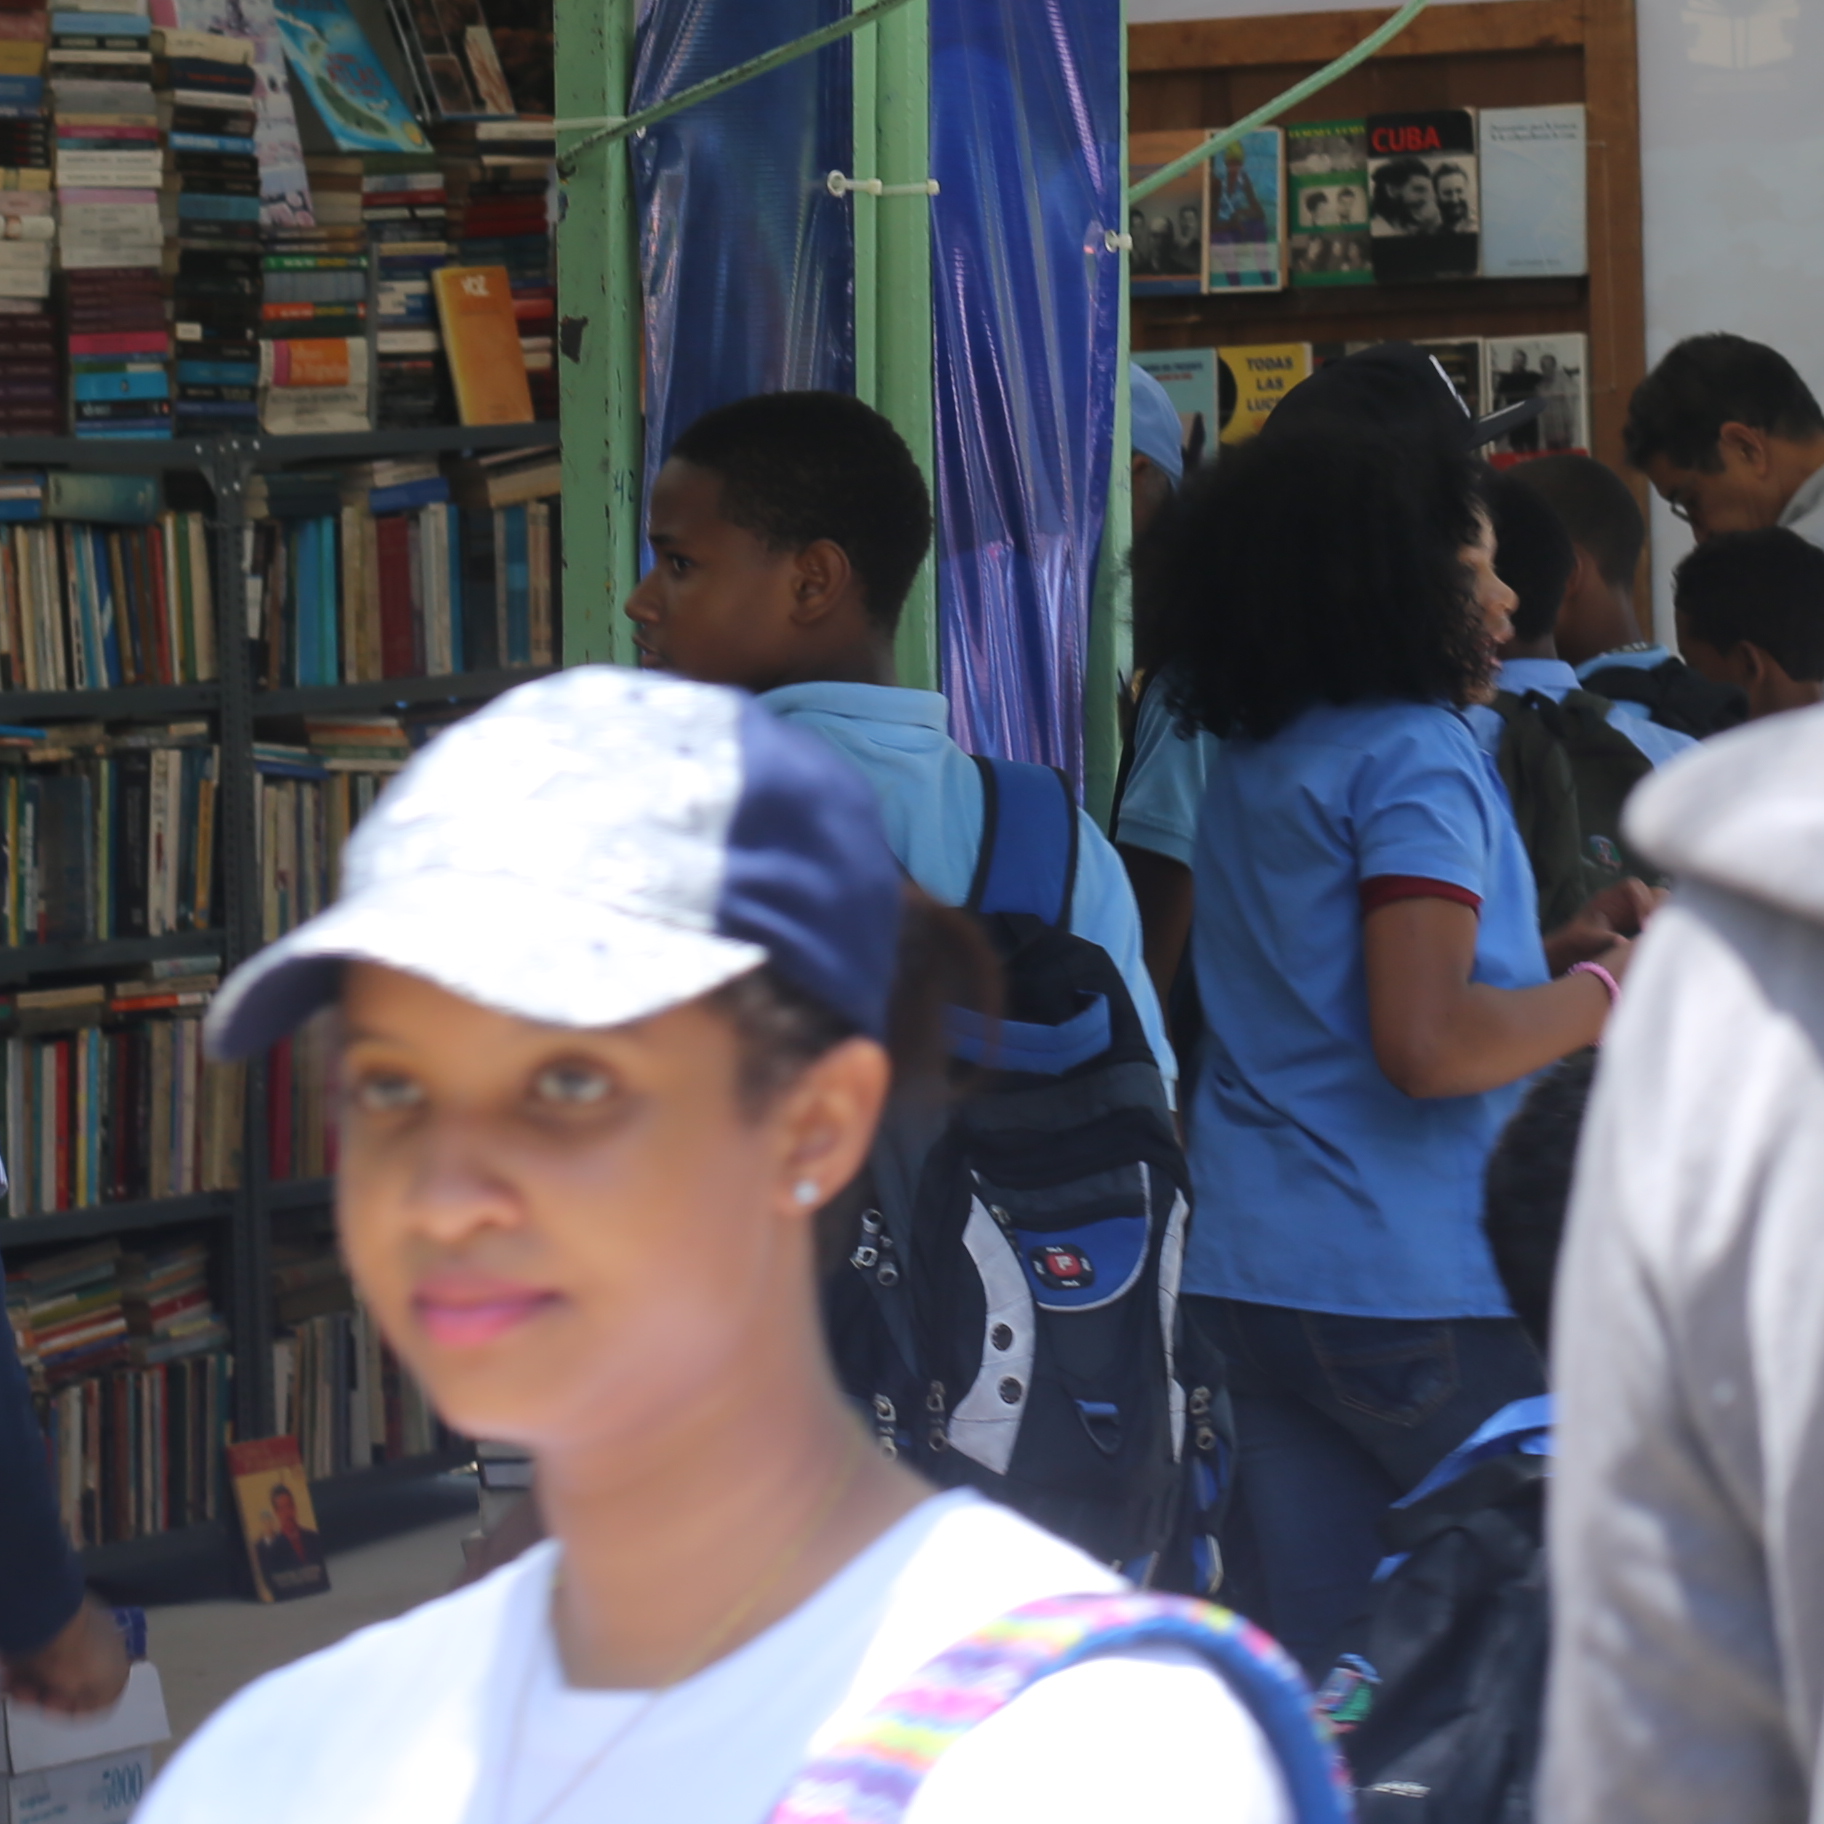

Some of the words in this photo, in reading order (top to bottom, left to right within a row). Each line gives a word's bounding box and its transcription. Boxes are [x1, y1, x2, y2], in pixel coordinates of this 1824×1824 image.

[1371, 126, 1442, 153] CUBA
[1246, 357, 1294, 371] TODAS
[1256, 378, 1284, 391] LAS
